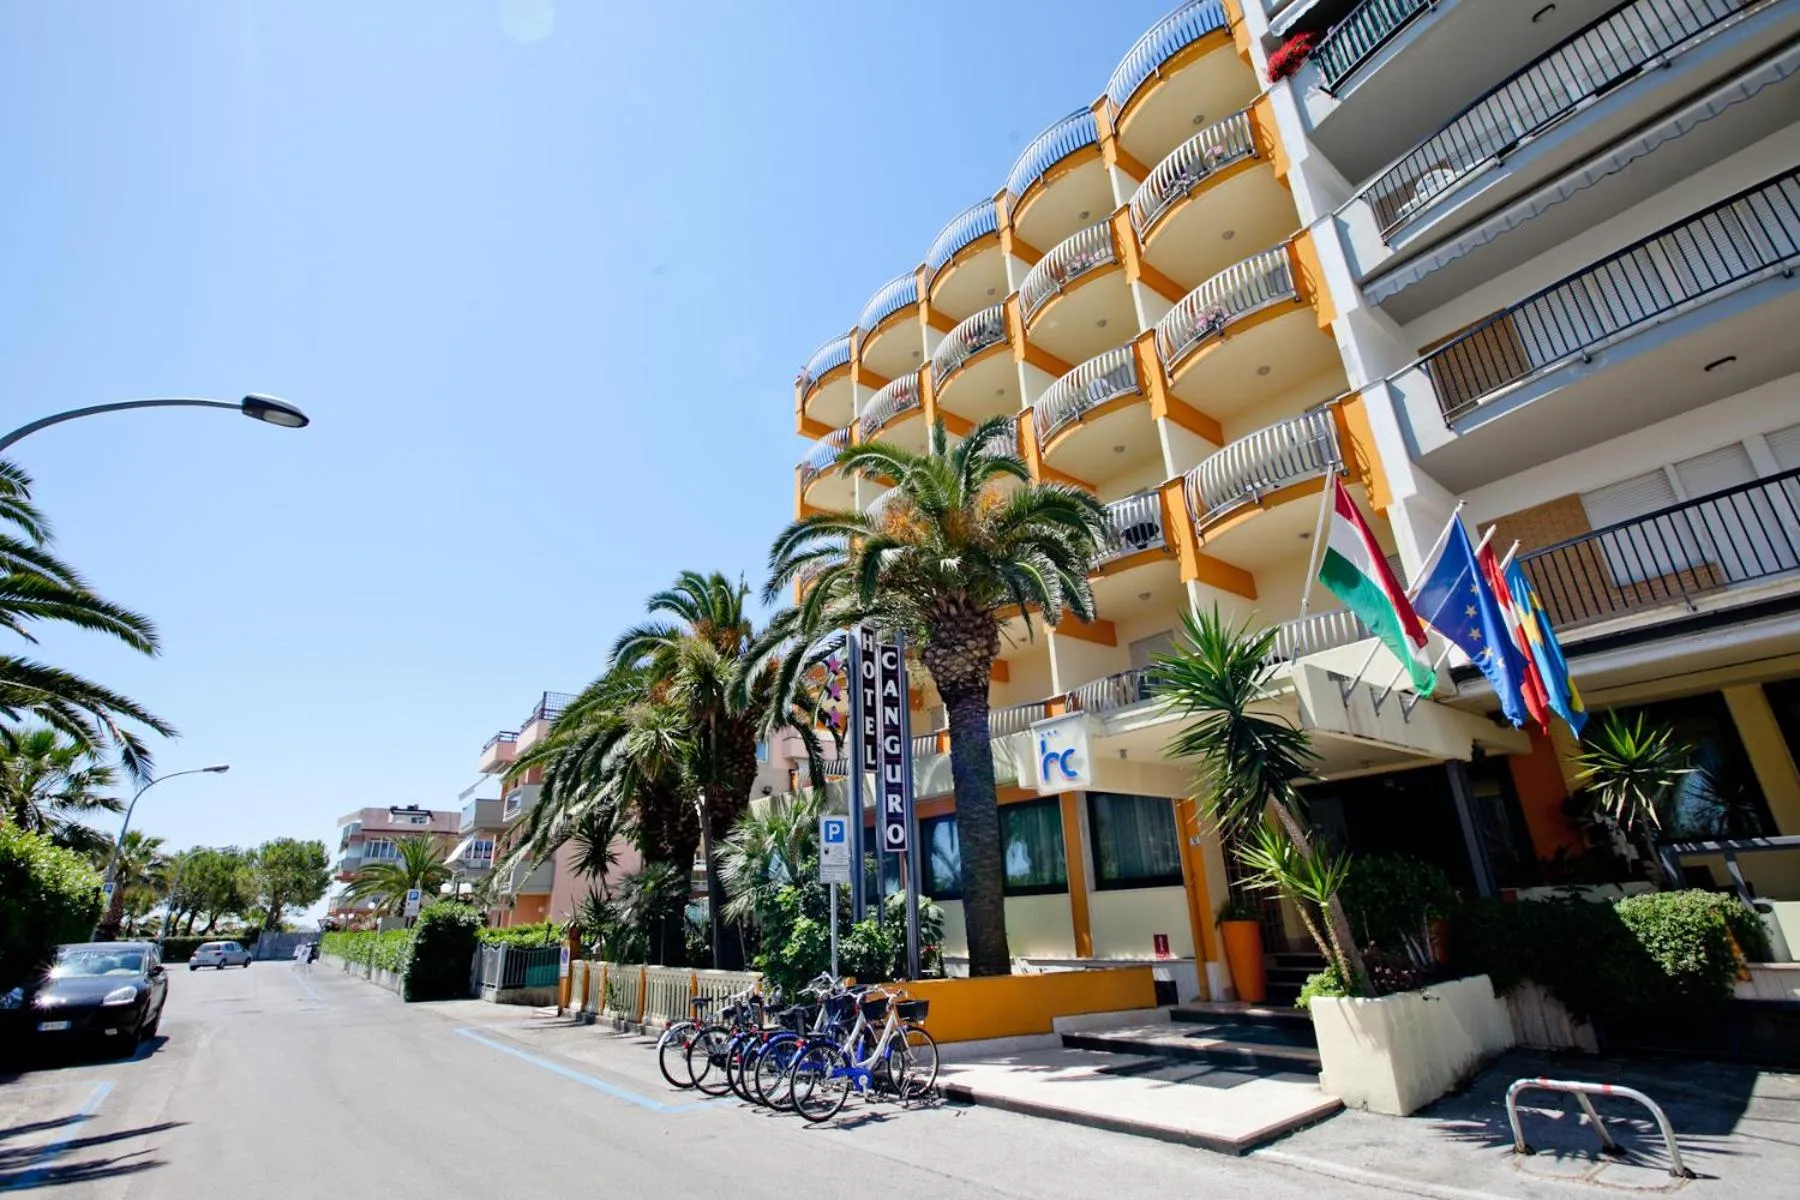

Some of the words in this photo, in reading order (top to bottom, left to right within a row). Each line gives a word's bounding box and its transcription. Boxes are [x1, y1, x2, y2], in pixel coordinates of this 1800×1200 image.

[862, 632, 876, 765] HOTEL
[881, 651, 905, 844] CANGURO
[828, 823, 841, 841] P
